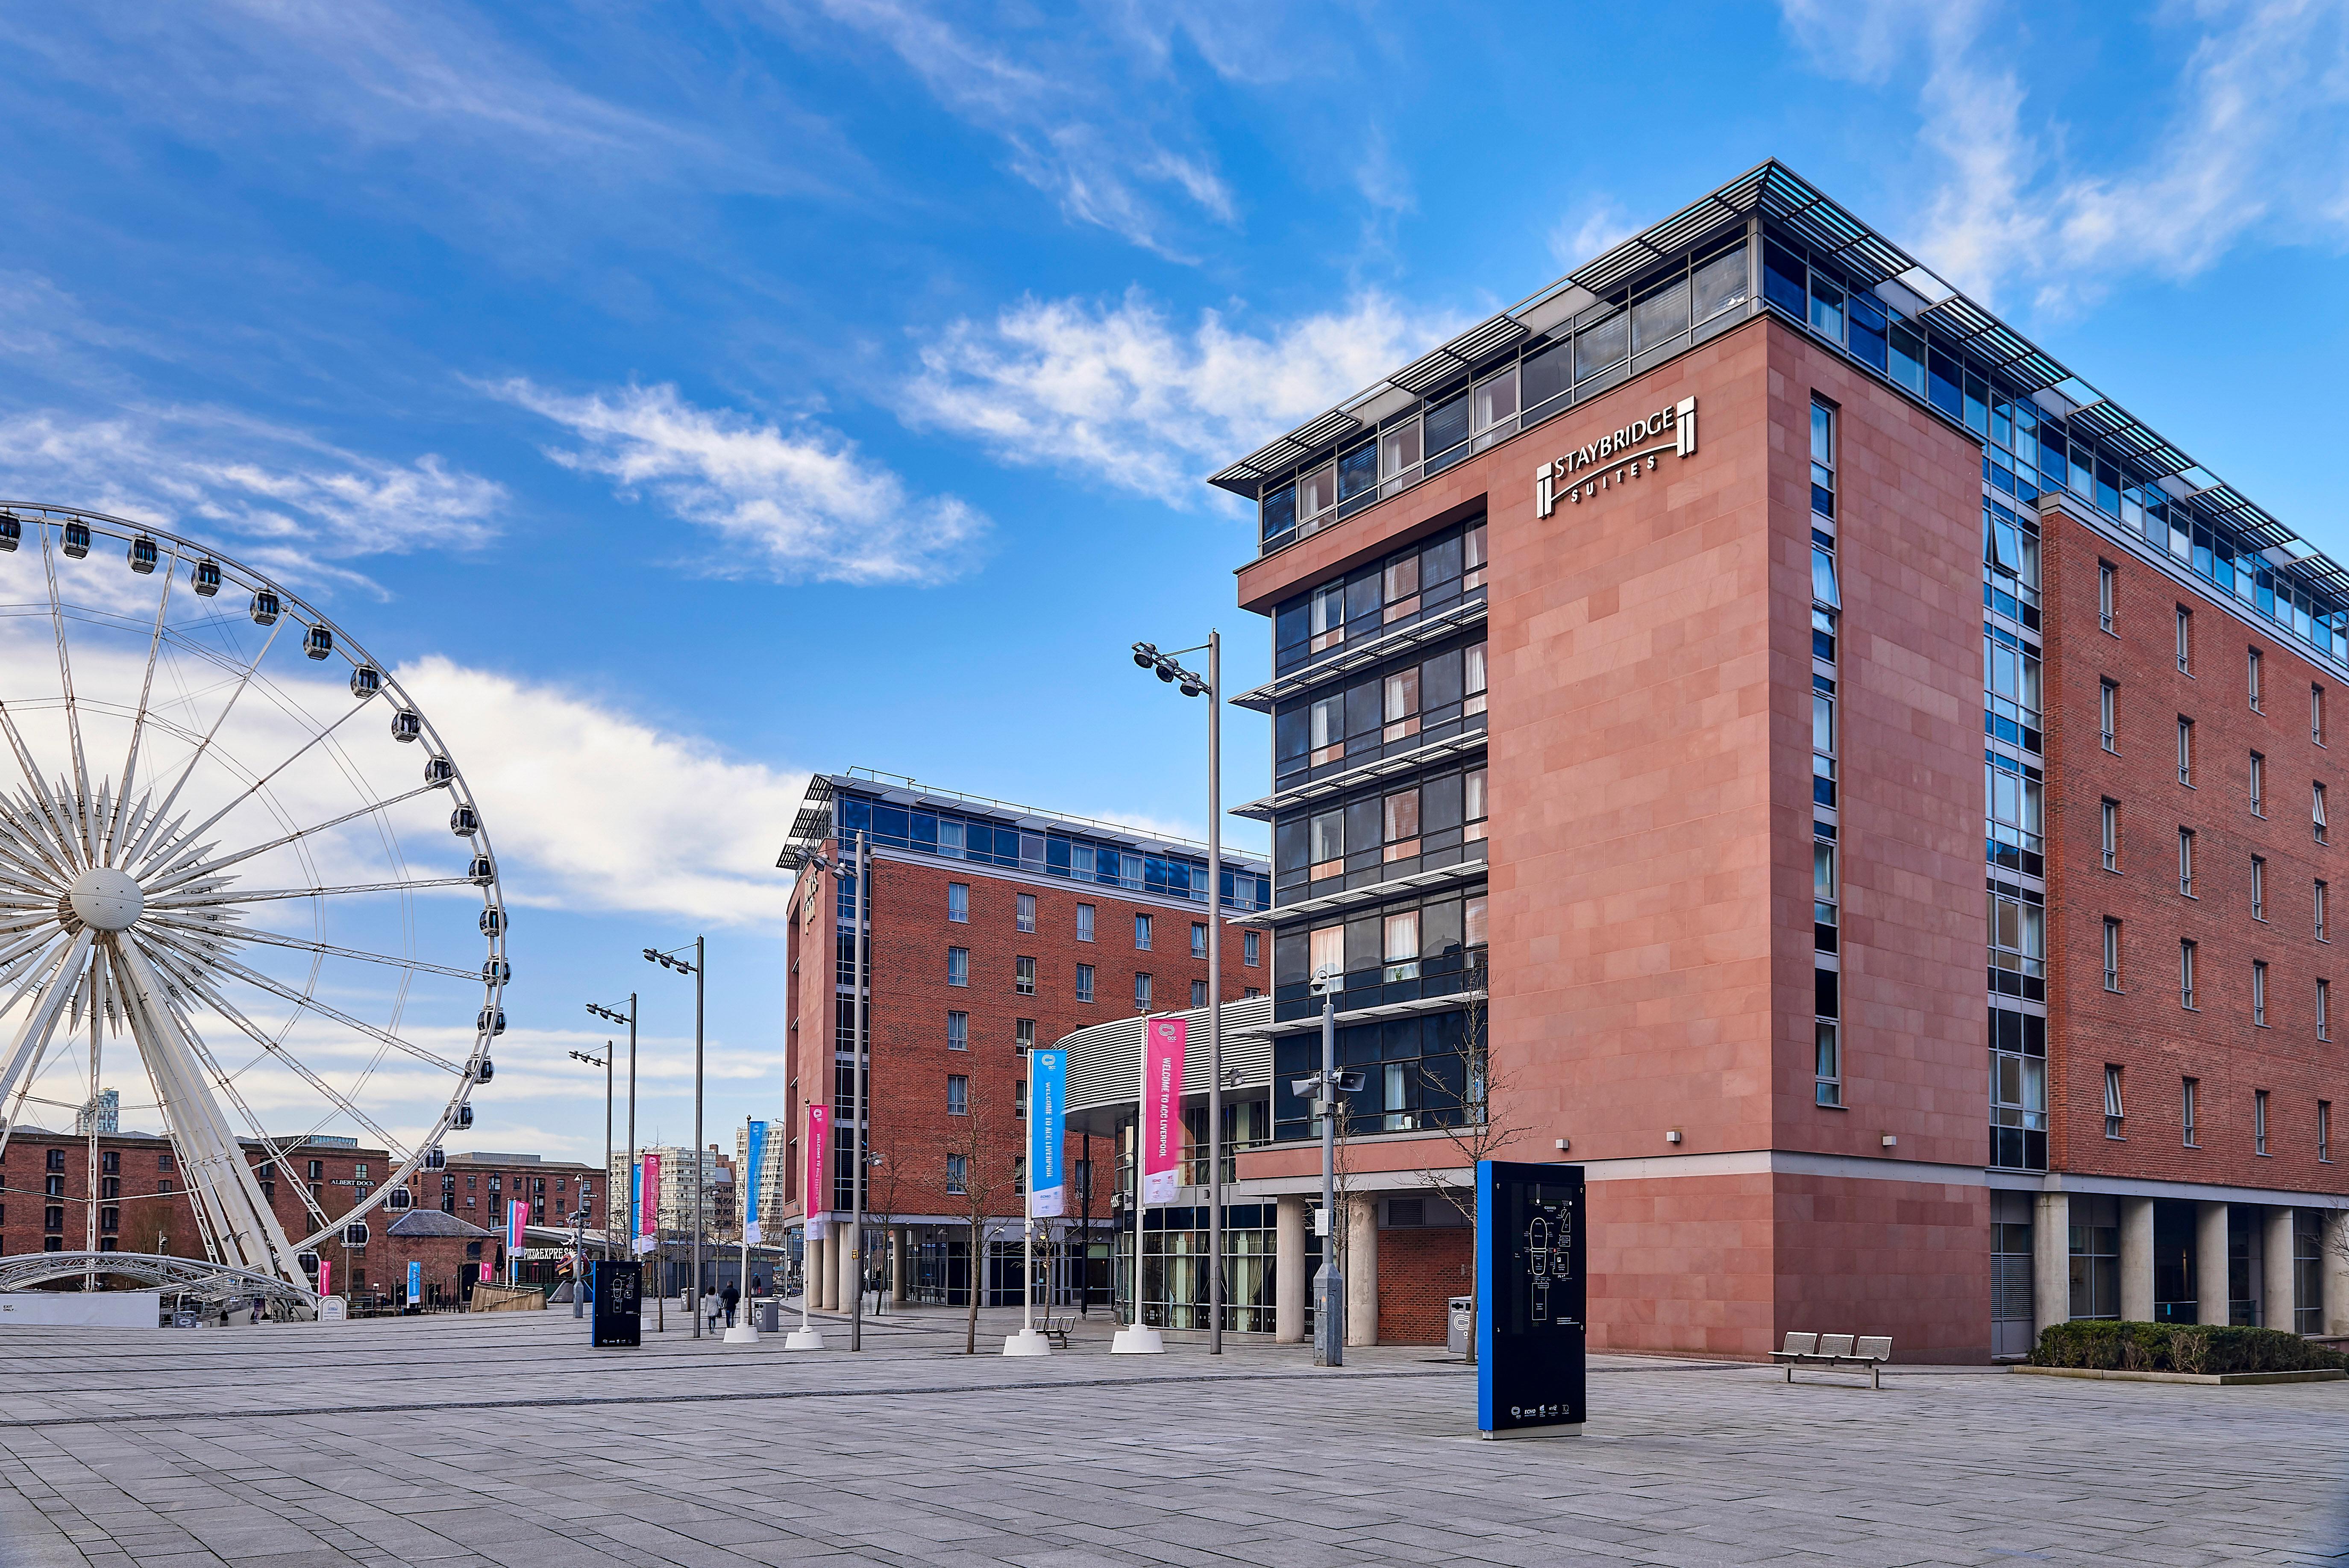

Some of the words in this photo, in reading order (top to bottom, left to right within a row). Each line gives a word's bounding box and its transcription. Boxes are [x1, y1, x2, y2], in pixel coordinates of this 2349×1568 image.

[1554, 405, 1674, 478] STAYBRIDGE
[1571, 455, 1655, 502] SUITES
[1161, 1057, 1171, 1092] WELCOME
[1160, 1093, 1169, 1103] TO
[1160, 1104, 1169, 1119] ACC
[1045, 1116, 1053, 1126] TO
[1159, 1119, 1168, 1158] LIVERPOOL
[1045, 1142, 1054, 1178] LIVERPOOL
